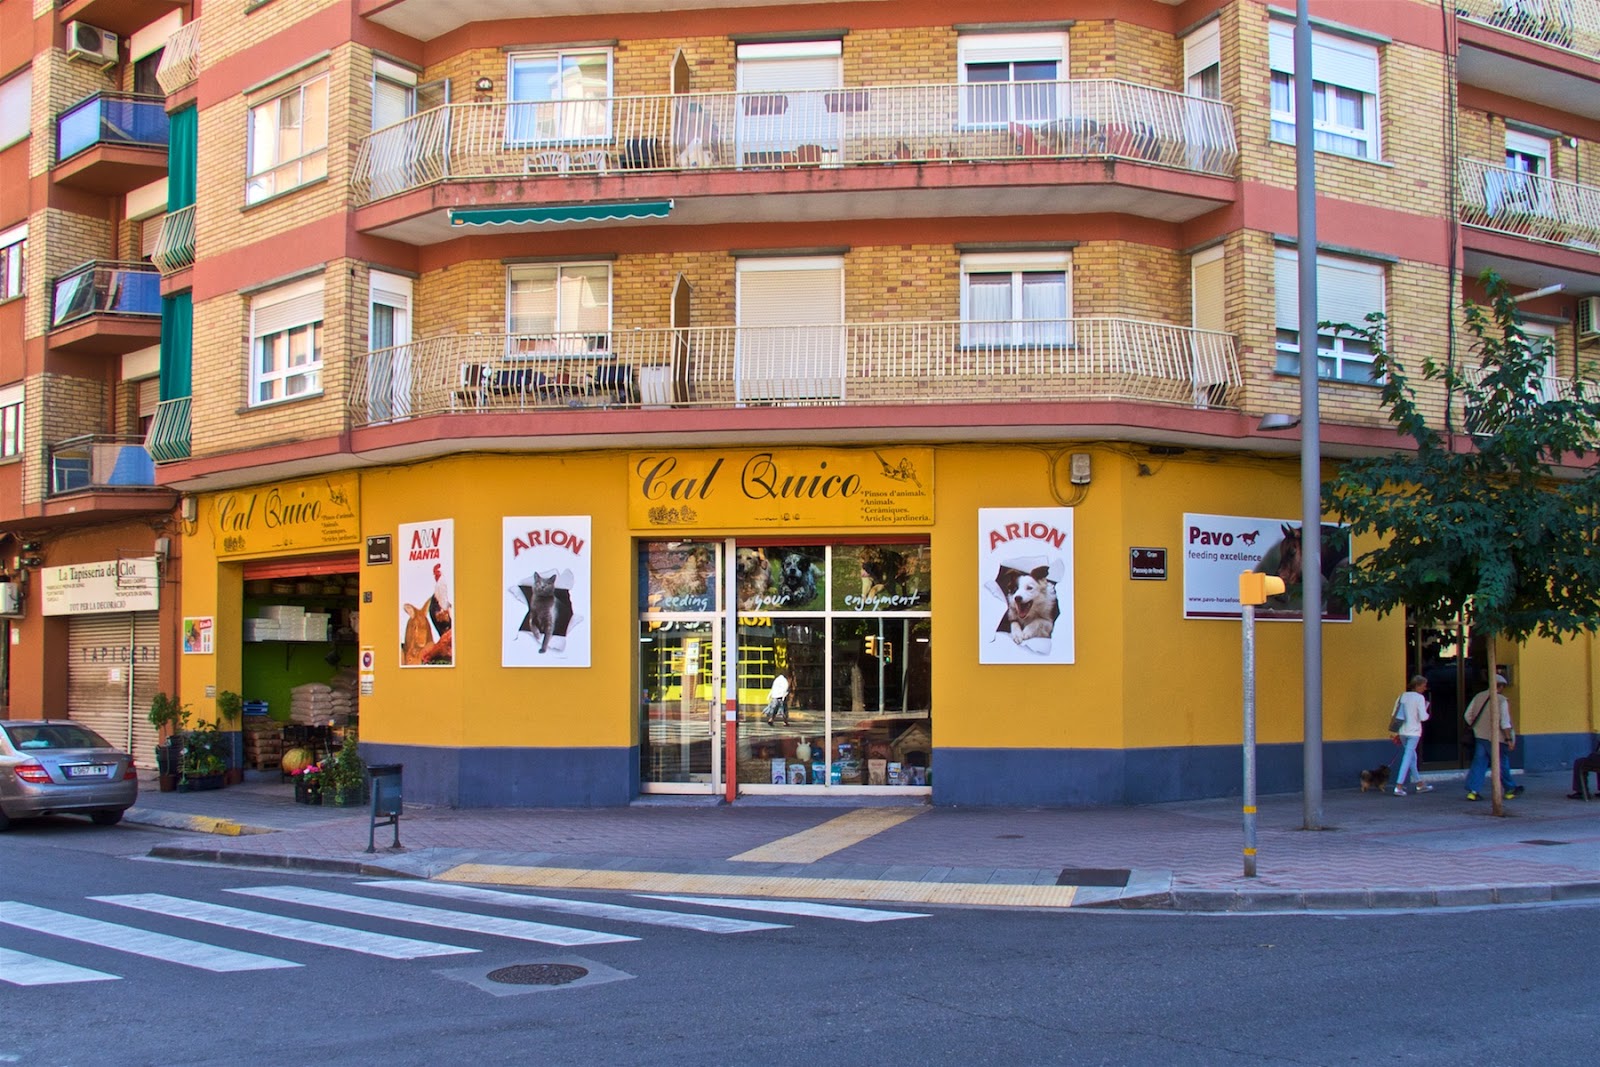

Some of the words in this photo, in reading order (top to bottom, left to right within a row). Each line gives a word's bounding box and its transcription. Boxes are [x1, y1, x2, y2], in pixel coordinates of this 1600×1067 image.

[637, 456, 724, 501] Cal
[741, 453, 863, 500] Quico
[217, 494, 258, 532] Cal
[264, 488, 322, 528] Quico
[512, 529, 585, 560] ARION
[989, 522, 1067, 553] ARION
[1189, 526, 1234, 546] Pavo
[409, 548, 441, 561] NANTA
[1188, 550, 1219, 562] feeding
[1219, 553, 1262, 562] excellence
[58, 568, 68, 580] La
[120, 561, 136, 576] Clot
[754, 593, 791, 612] your
[844, 588, 920, 612] enjoyment
